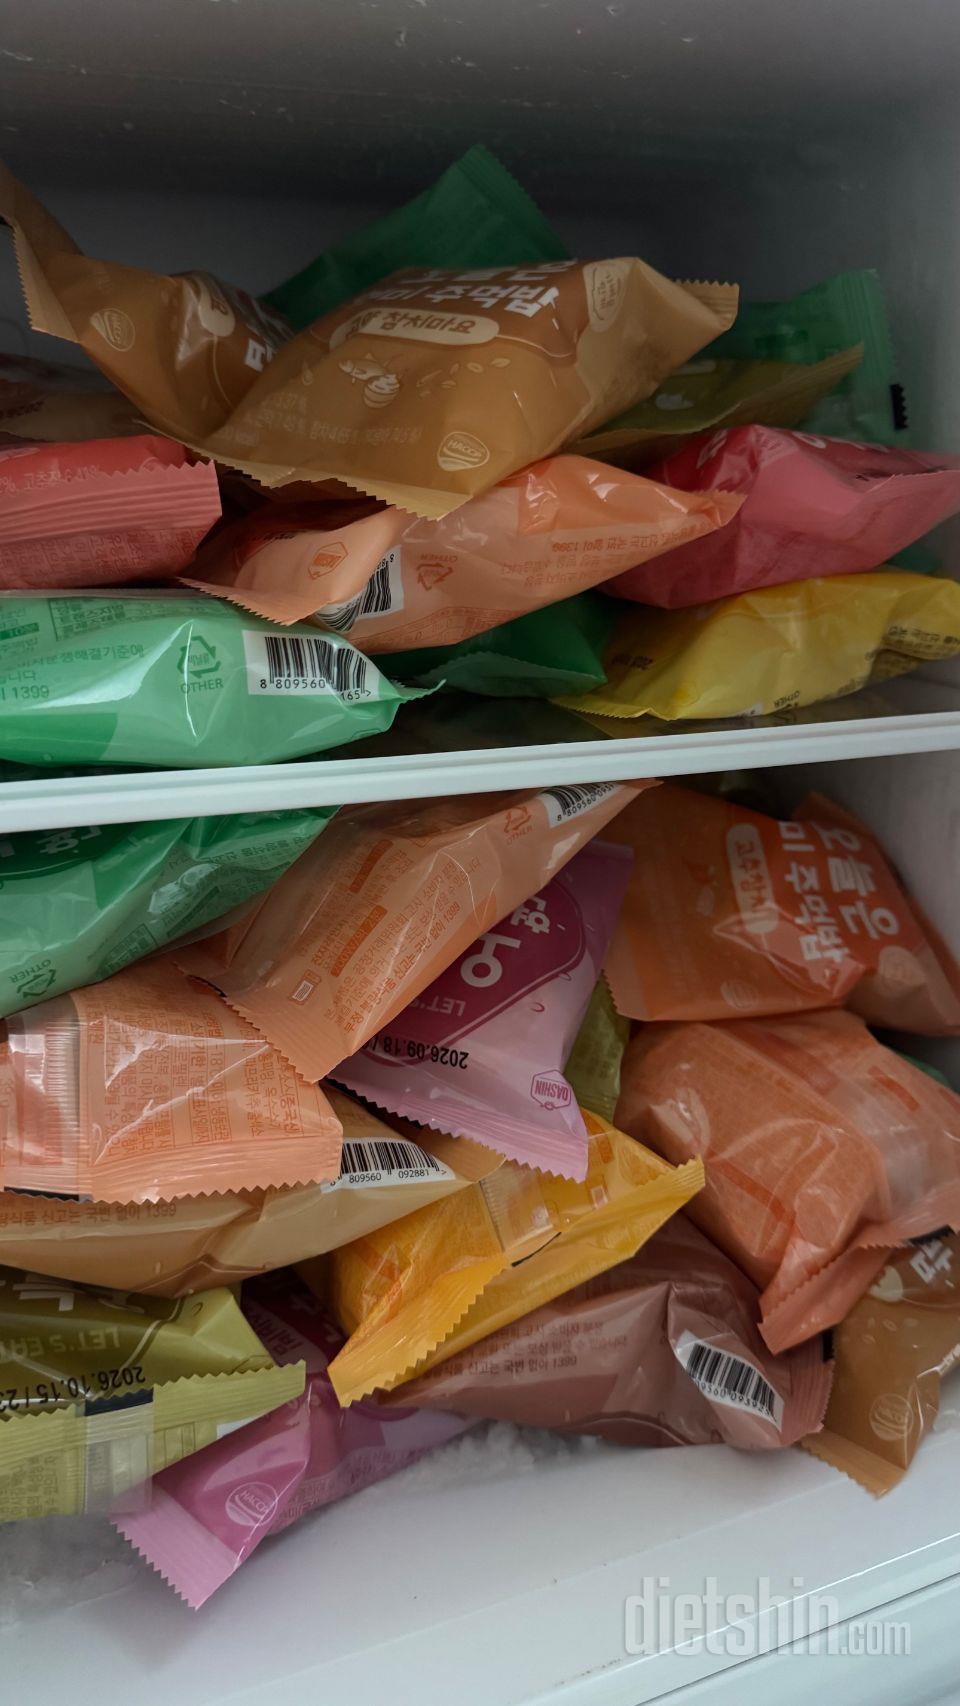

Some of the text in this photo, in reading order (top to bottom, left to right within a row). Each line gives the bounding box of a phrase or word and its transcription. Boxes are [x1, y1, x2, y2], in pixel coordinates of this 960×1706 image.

[425, 285, 559, 317] 주먹밥
[380, 310, 477, 334] 참치마요
[445, 438, 483, 457] HACCP
[551, 540, 579, 553] 1399
[11, 683, 50, 701] 1399
[179, 675, 224, 696] OTHER
[259, 678, 267, 689] 8
[274, 675, 326, 693] 809560
[780, 822, 848, 964] 미 주먹밥
[812, 822, 900, 939] 오늘은
[509, 896, 550, 934] 현
[7, 957, 52, 984] OTHER
[459, 932, 521, 988] 오
[382, 1035, 468, 1069] 2026.09.18
[348, 1167, 430, 1184] 809560 092881
[39, 1207, 82, 1225] 신고는
[83, 1205, 112, 1224] 국번
[115, 1204, 141, 1222] 없이
[146, 1201, 177, 1218] 1399
[909, 1237, 953, 1284] 밥
[47, 1325, 121, 1355] LET'S
[36, 1366, 146, 1404] 2026.10.15
